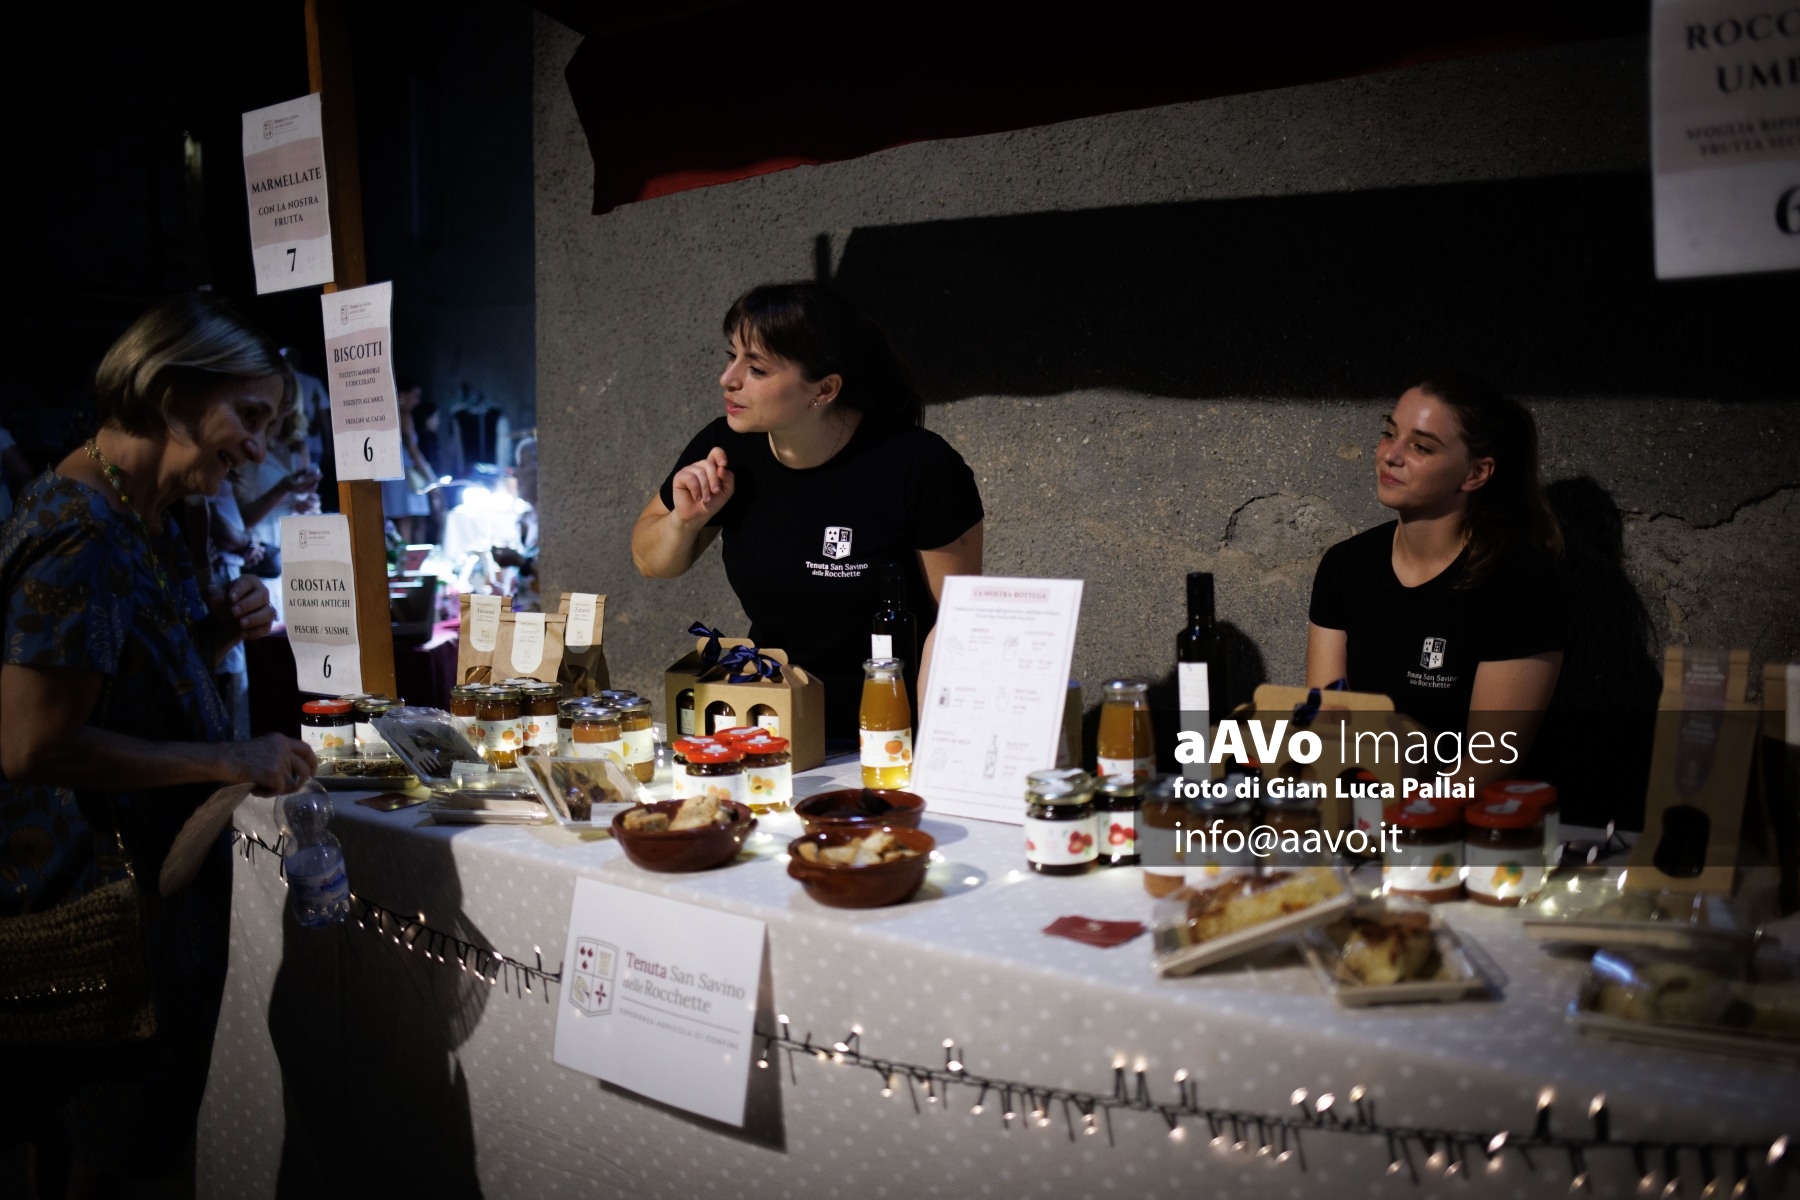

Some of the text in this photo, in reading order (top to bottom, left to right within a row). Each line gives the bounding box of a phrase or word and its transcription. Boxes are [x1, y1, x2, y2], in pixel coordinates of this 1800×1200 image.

[251, 167, 322, 194] MARMELLATE
[258, 196, 319, 216] CON LA NOSTRA
[1775, 185, 1800, 236] 6
[274, 214, 304, 227] FRUTTA
[287, 248, 297, 272] 7
[333, 341, 382, 363] BISCOTTI
[363, 436, 373, 462] 6
[805, 561, 869, 571] Tenuta San Savino
[290, 579, 346, 591] CROSTATA
[297, 598, 319, 607] GRANI
[320, 599, 350, 608] ANTICHI
[294, 625, 319, 634] PESCHE
[324, 625, 350, 635] SUSINE
[323, 654, 332, 678] 6
[626, 952, 746, 1000] Tenuta San Savino
[644, 980, 712, 1014] Rocchette
